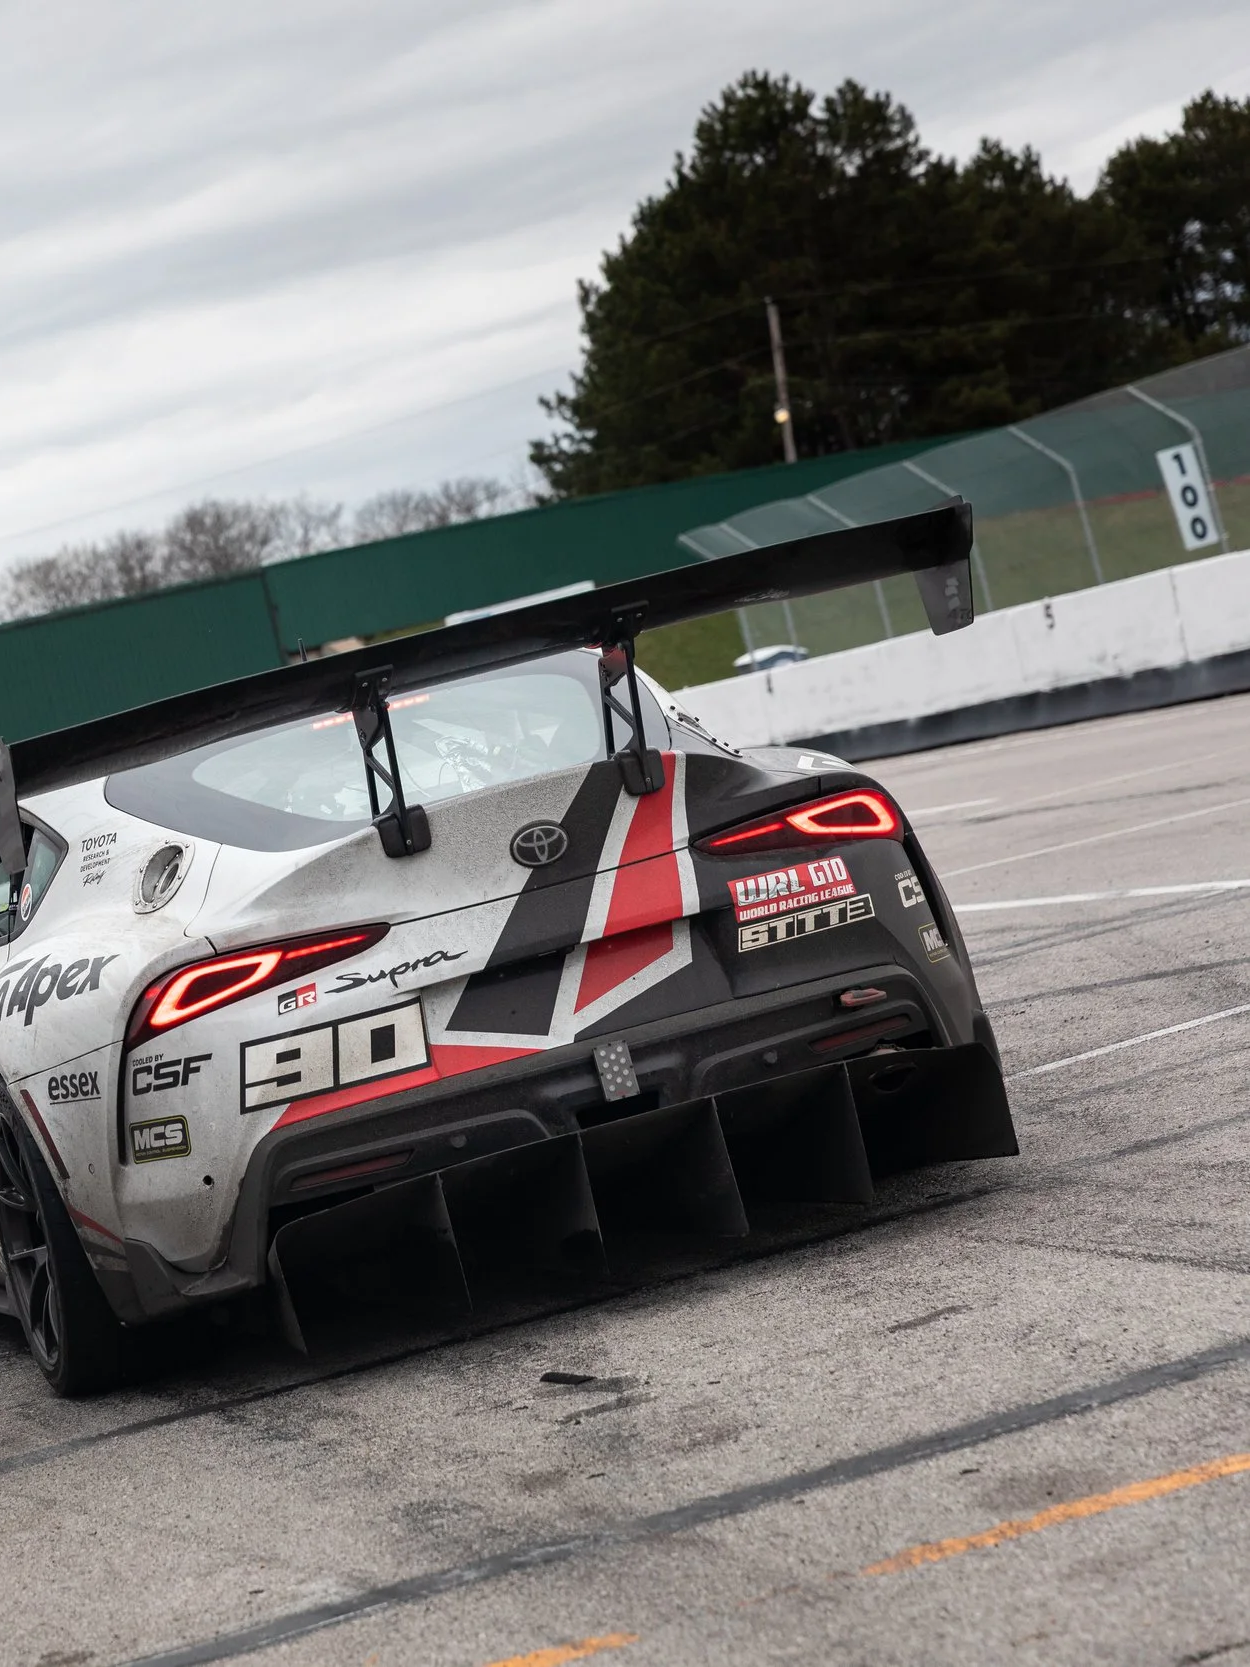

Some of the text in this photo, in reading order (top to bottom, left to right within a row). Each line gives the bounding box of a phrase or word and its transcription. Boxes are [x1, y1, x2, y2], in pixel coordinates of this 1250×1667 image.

[1172, 452, 1208, 540] 100
[81, 832, 118, 853] TOYOTA
[82, 851, 105, 862] RESEARCH
[79, 857, 111, 873] DEVELOPMENT
[735, 857, 848, 907] WRL GTO
[739, 883, 855, 922] WORLD RACING LEAGUE
[278, 950, 469, 1014] GR Supra
[132, 1053, 165, 1067] COOLED BY
[244, 1001, 428, 1108] 90
[48, 1071, 101, 1101] essex
[132, 1052, 213, 1097] CSF
[133, 1122, 184, 1151] MCS
